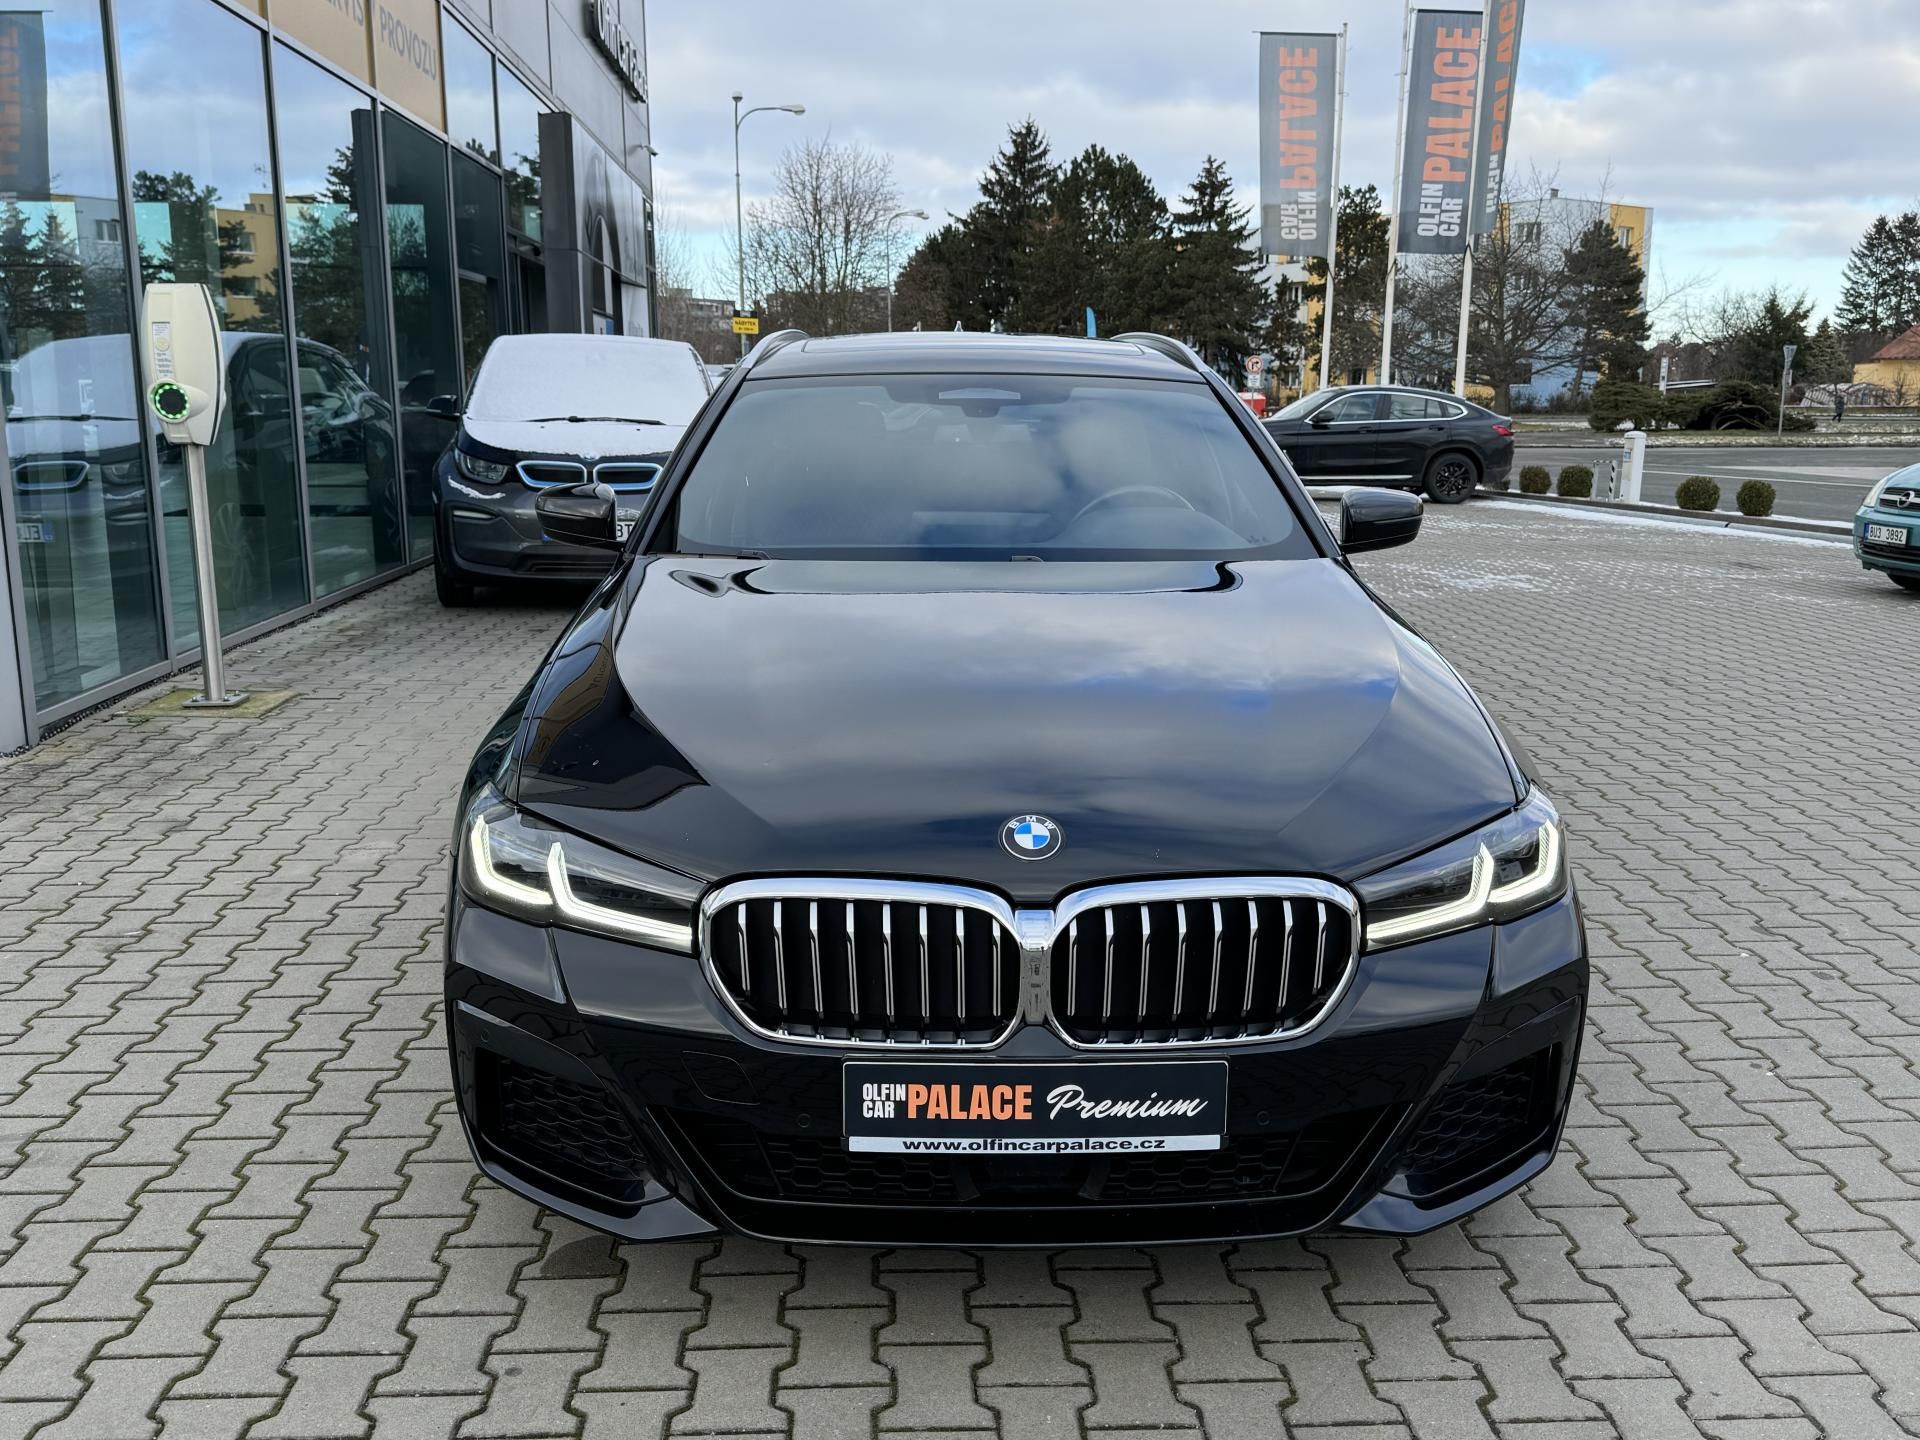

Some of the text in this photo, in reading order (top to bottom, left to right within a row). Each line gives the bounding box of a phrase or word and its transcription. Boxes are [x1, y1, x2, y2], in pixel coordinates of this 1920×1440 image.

[379, 5, 436, 80] PROVOZU
[1490, 0, 1516, 152] PALAC
[1423, 27, 1480, 182] PALACE
[1417, 183, 1443, 237] OLFIN
[1438, 198, 1463, 237] CAR
[1886, 528, 1904, 543] 3892
[862, 1083, 906, 1101] OLFIN
[862, 1101, 895, 1119] CAR
[907, 1084, 1209, 1121] PALACE Premium
[902, 1138, 1166, 1153] www.olfincarpalace.cz
